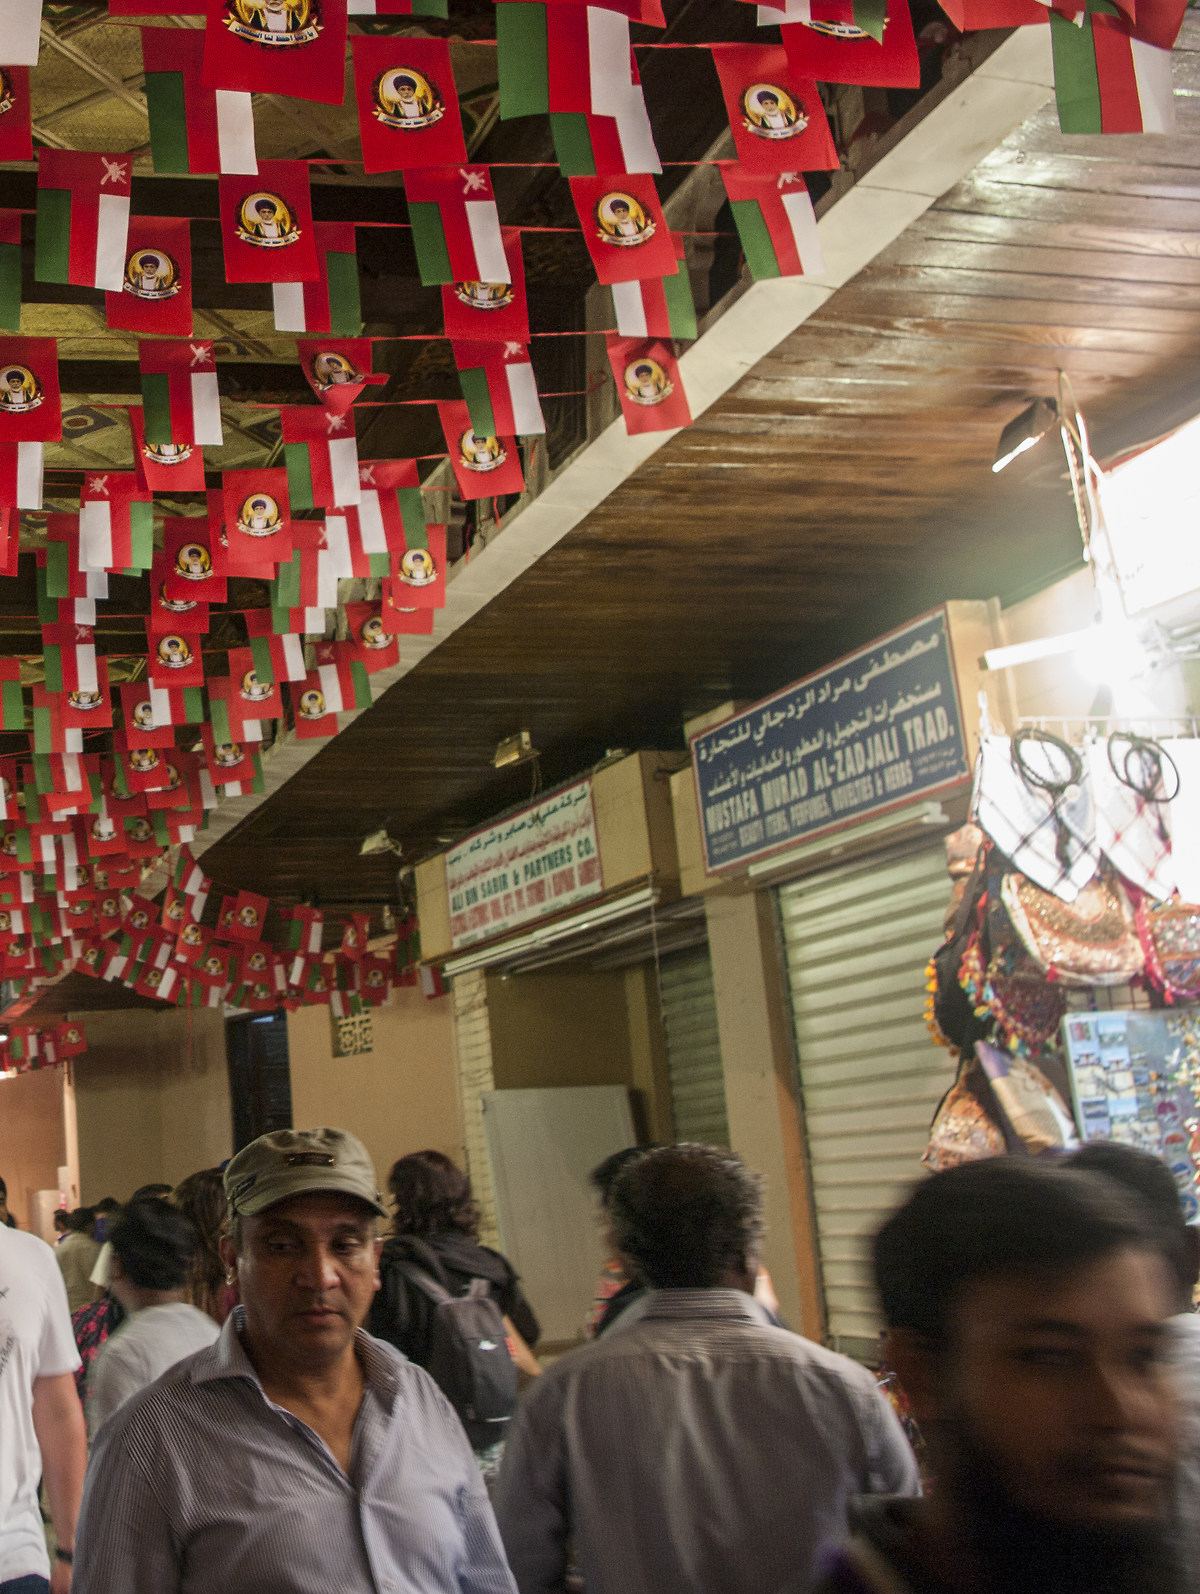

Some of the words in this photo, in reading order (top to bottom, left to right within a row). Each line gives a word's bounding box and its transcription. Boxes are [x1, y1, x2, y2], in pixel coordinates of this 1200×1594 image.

[853, 634, 939, 692] مصطفى
[753, 690, 816, 746] الزدجالي
[817, 679, 851, 707] مراد
[873, 682, 941, 723] مستحضرات
[700, 722, 750, 762] للتجارة
[705, 788, 759, 835] MUSTAFA
[761, 767, 808, 811] MURAD
[813, 726, 900, 791] AL-ZADJALI
[903, 706, 955, 753] TRAD.
[452, 893, 463, 913] ALI
[465, 887, 478, 906] BIN
[481, 873, 508, 898] SABIR
[513, 869, 519, 886] &
[524, 844, 572, 881] PARTNERS
[577, 837, 595, 858] CO.
